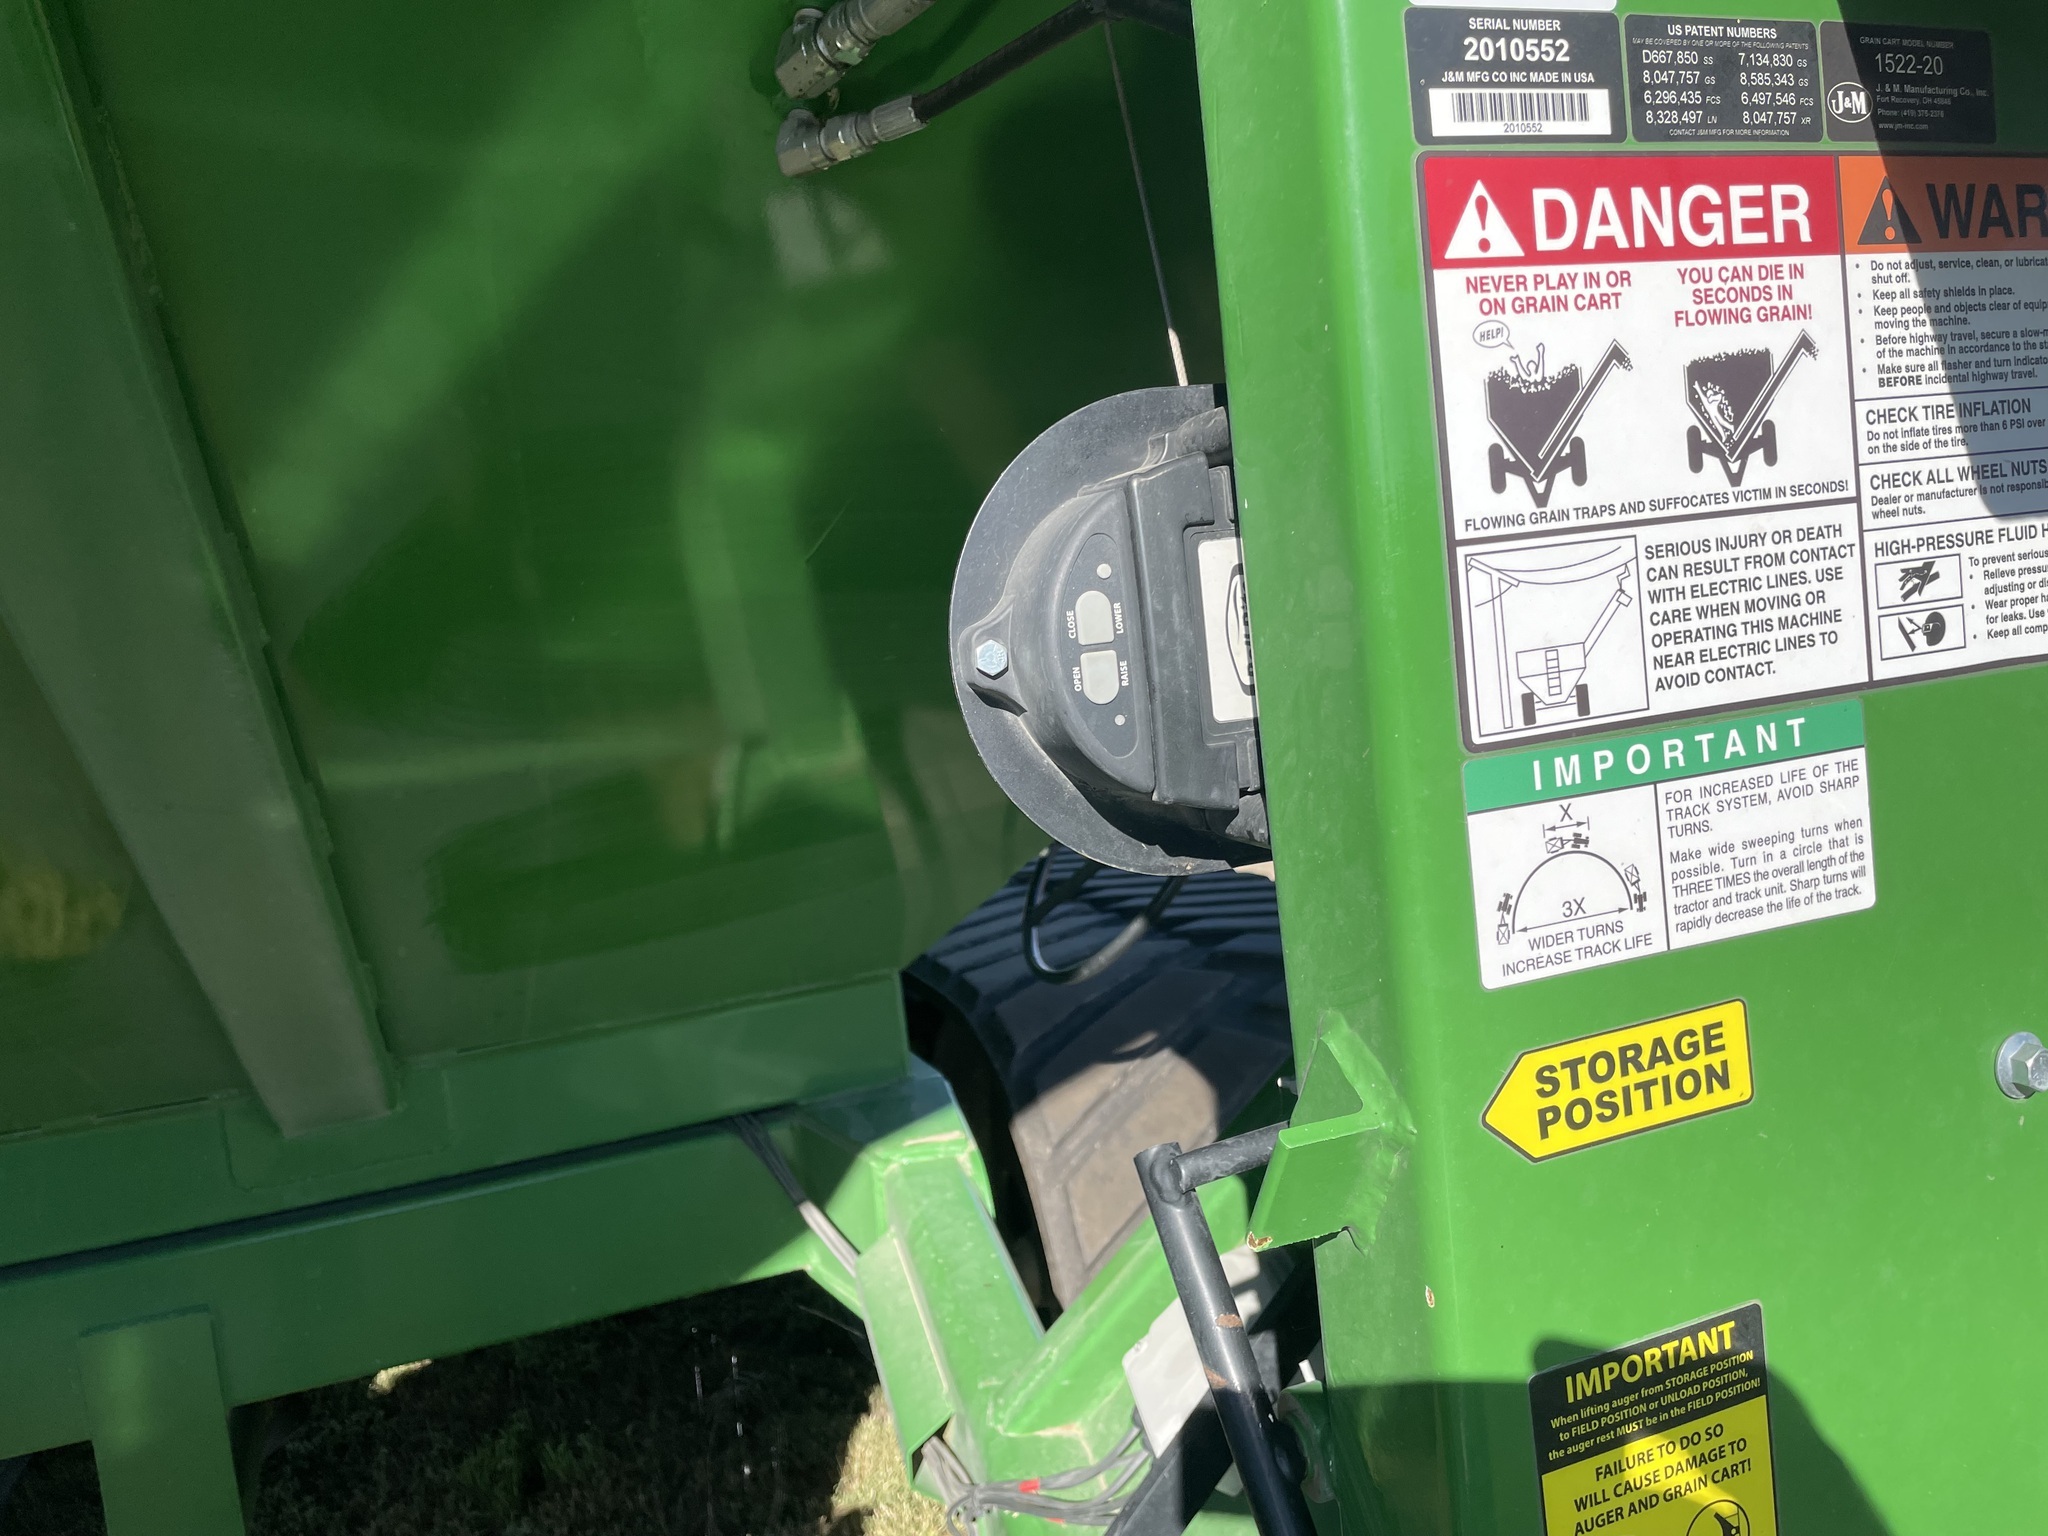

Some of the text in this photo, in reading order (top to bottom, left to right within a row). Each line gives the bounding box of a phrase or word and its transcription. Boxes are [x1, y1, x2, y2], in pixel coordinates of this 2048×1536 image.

[1469, 18, 1560, 31] SERIAL NUMBER
[1668, 25, 1777, 38] US PATENT NUMBERS
[1464, 37, 1570, 61] 2010552
[1642, 50, 1698, 65] D667,850
[1738, 53, 1792, 67] 7,134,830
[1797, 59, 1807, 67] GS
[1442, 72, 1594, 83] J&M MFG CO INC MADE IN USA
[1643, 70, 1700, 85] 8,047,757
[1740, 73, 1794, 86] 8,585,343
[1875, 53, 1943, 75] 1522-20
[1644, 91, 1701, 105] 6,296,435
[1706, 96, 1721, 104] FCS
[1741, 92, 1795, 106] 6,497,546
[1832, 91, 1866, 114] J&M
[1504, 123, 1542, 133] 2010552
[1646, 111, 1702, 125] 8,328,497
[1743, 112, 1796, 125] 8,047,757
[1532, 184, 1812, 251] DANGER
[1466, 271, 1632, 294] NEVER PLAY IN OR
[1677, 263, 1804, 285] YOU CAN DIE IN
[1479, 292, 1622, 316] ON GRAIN CART
[1692, 285, 1793, 305] SECONDS IN
[1872, 285, 2015, 302] Keep all safety shields in place.
[1674, 305, 1812, 327] FLOWING GRAIN!
[1479, 327, 1504, 342] HELP!
[1866, 398, 2031, 425] CHECK TIRE INFLATION
[1868, 437, 1968, 454] on the side of the tire.
[1870, 459, 2047, 490] CHECK ALL WHEEL NUTS
[1465, 480, 1848, 532] FLOWING GRAIN TRAPS AND SUFFOCATES VICTIM IN SECONDS!
[1645, 524, 1842, 560] SERIOUS INJURY OR DEATH
[1874, 525, 2037, 557] HIGH-PRESSURE FLUID
[1646, 544, 1856, 582] CAN RESULT FROM CONTACT
[1648, 567, 1843, 604] WITH ELECTRIC LINES. USE
[1114, 603, 1123, 633] LOWER
[1650, 591, 1826, 626] CARE WHEN MOVING OR
[1066, 610, 1076, 639] CLOSE
[1652, 609, 1842, 648] OPERATING THIS MACHINE
[1653, 631, 1838, 670] NEAR ELECTRIC LINES TO
[1120, 661, 1128, 686] RAISE
[1655, 662, 1776, 692] AVOID CONTACT.
[1533, 718, 1806, 791] IMPORTANT
[1665, 759, 1859, 805] FOR INCREASED LIFE OF THE
[1559, 803, 1573, 821] X
[1667, 775, 1860, 822] TRACK SYSTEM, AVOID SHARP
[1668, 821, 1713, 839] TURNS.
[1669, 817, 1863, 864] Make wide sweeping turns when
[1562, 897, 1587, 918] 3X
[1528, 921, 1624, 951] WIDER TURNS
[1502, 933, 1653, 977] INCREASE TRACK LIFE
[1535, 1020, 1726, 1098] STORAGE
[1538, 1060, 1730, 1140] POSITION
[1565, 1321, 1735, 1403] IMPORTANT
[1595, 1423, 1724, 1482] FAILURE TO DO SO
[1574, 1438, 1747, 1512] WILL CAUSE DAMAGE TO
[1574, 1458, 1751, 1536] AUGER AND GRAIN CART!
